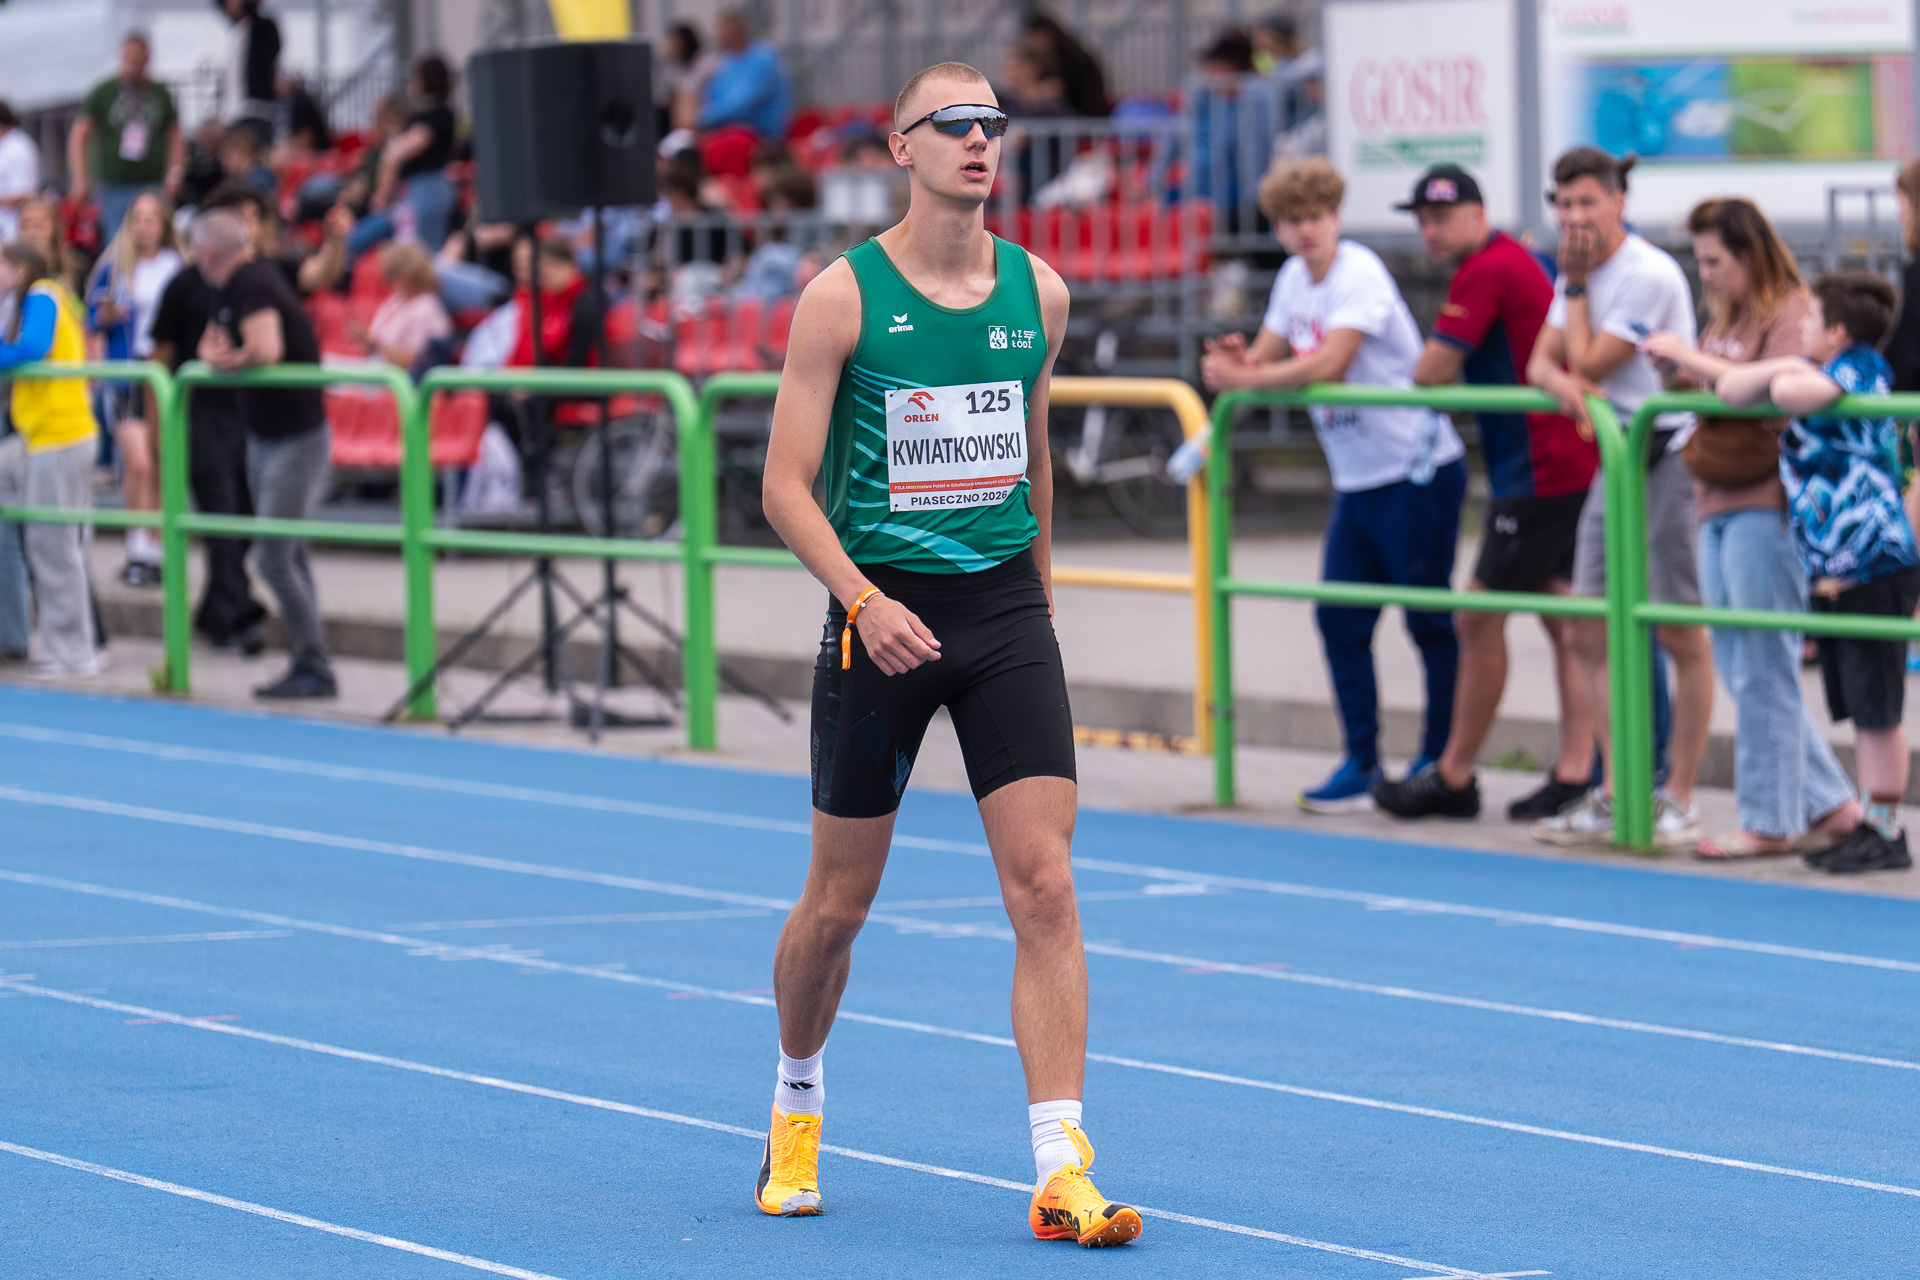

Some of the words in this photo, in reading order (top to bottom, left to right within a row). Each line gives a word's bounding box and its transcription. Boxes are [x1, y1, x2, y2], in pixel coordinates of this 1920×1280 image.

[888, 324, 914, 333] erima
[965, 388, 1011, 415] 125
[904, 413, 939, 423] ORLEN
[892, 432, 1022, 466] KWIATKOWSKI
[911, 493, 980, 506] PIASECZNO
[981, 490, 1008, 502] 2026
[1036, 1205, 1081, 1237] NITRO
